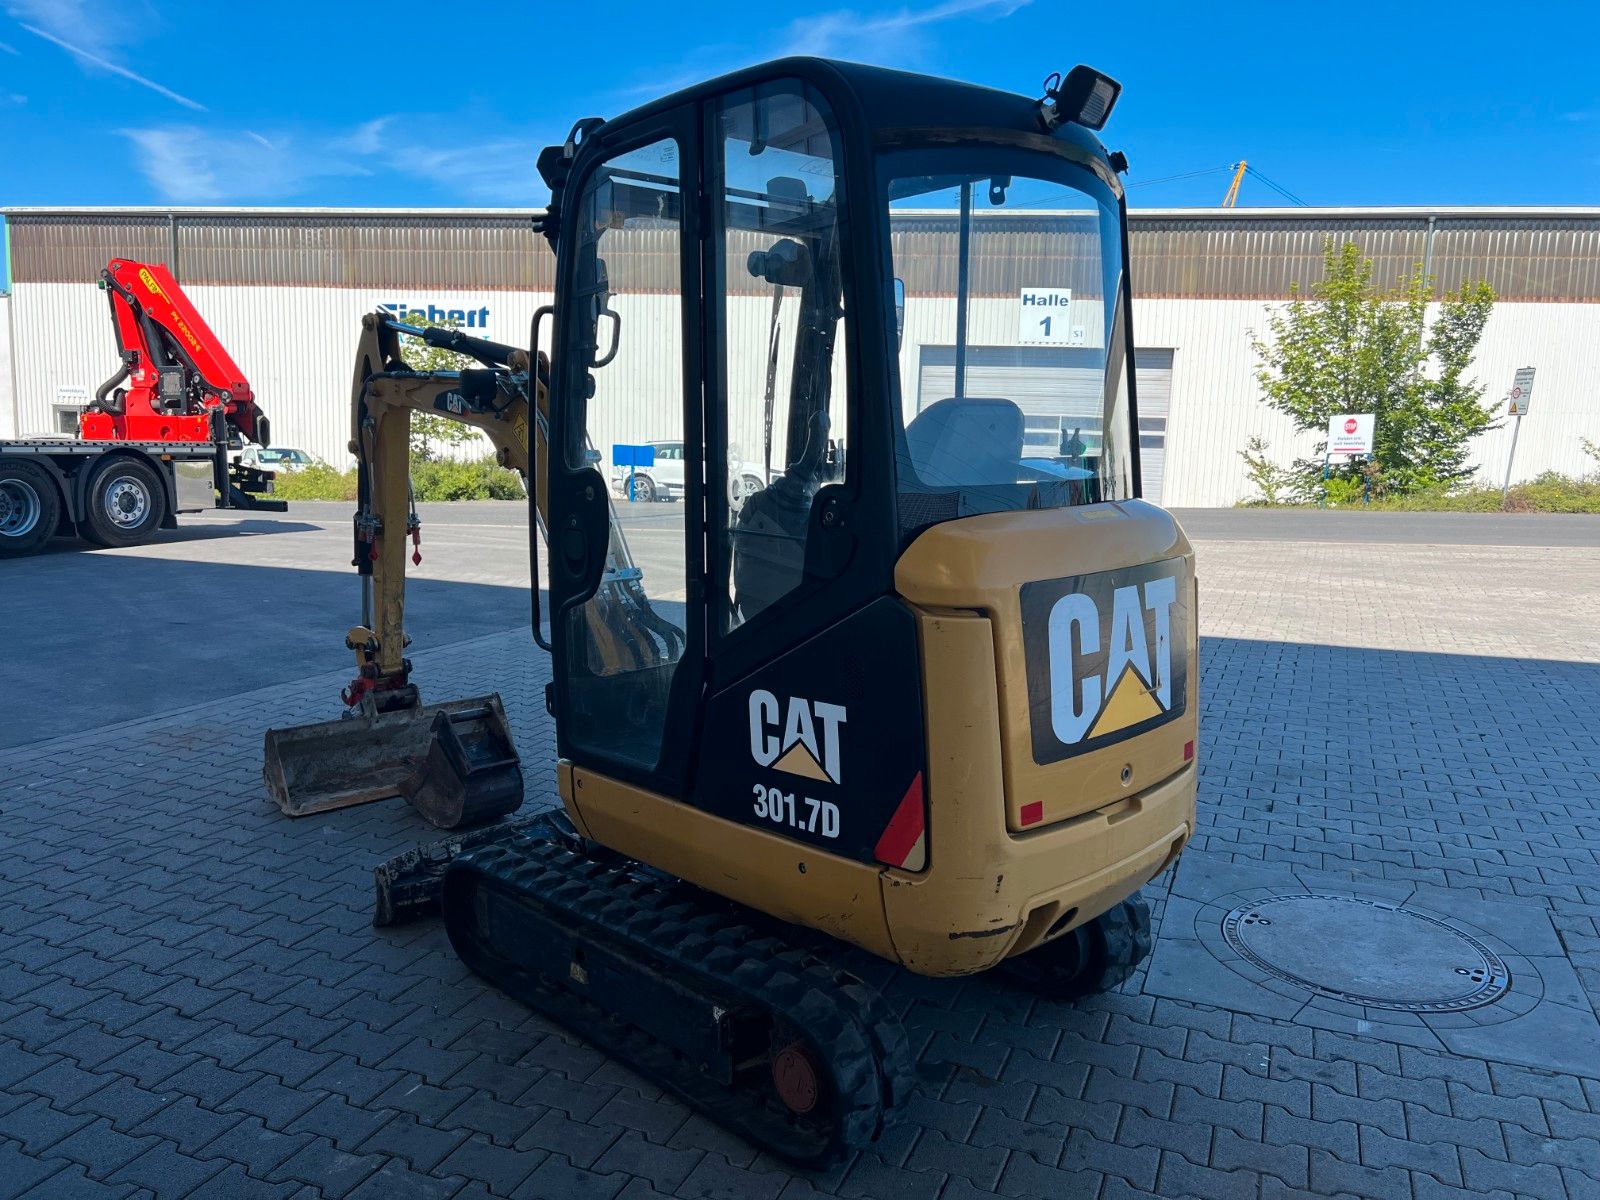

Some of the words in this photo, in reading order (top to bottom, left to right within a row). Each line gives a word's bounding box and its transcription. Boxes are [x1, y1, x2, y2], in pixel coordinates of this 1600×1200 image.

[1022, 294, 1069, 306] Halle
[170, 311, 180, 323] PK
[1039, 316, 1052, 337] 1
[446, 392, 464, 414] CAT
[1049, 576, 1177, 745] CAT
[749, 689, 848, 785] CAT
[752, 783, 840, 839] 301.7D
